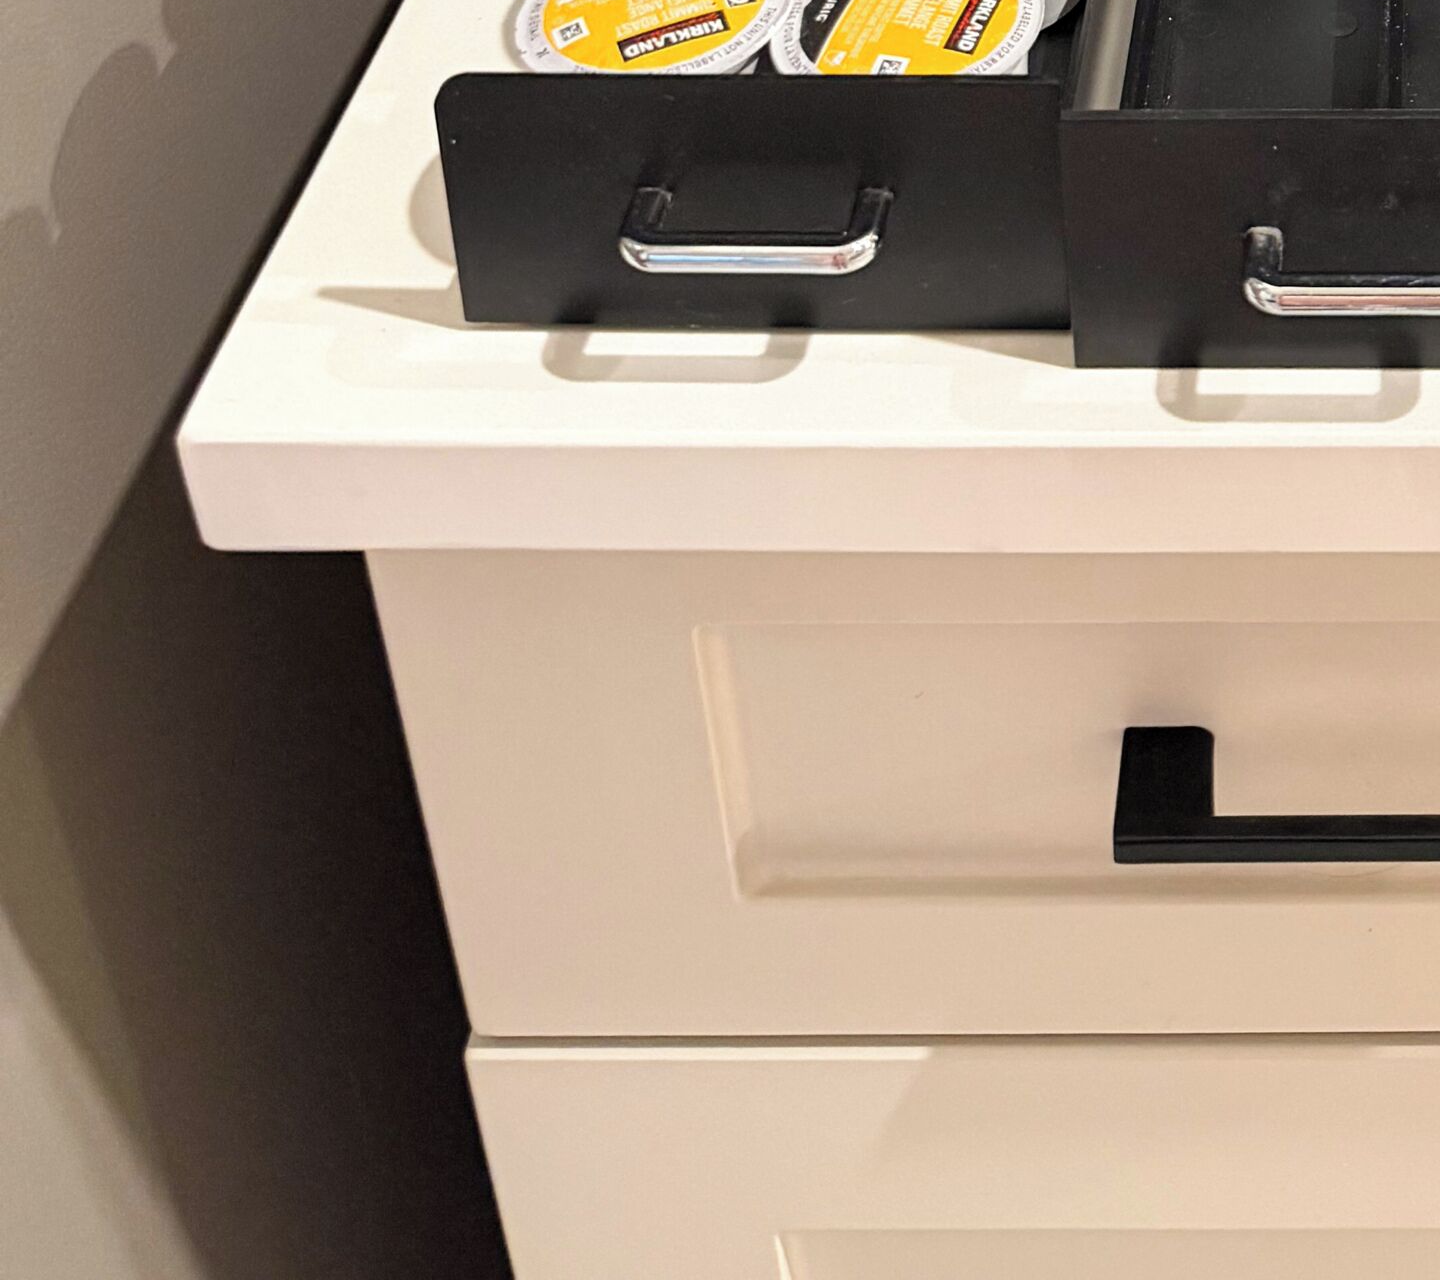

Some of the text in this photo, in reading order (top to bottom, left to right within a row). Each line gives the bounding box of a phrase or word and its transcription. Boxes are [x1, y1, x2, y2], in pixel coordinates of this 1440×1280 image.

[623, 18, 725, 58] KIRKLAND
[743, 23, 763, 40] UNIT
[724, 40, 743, 54] NOT
